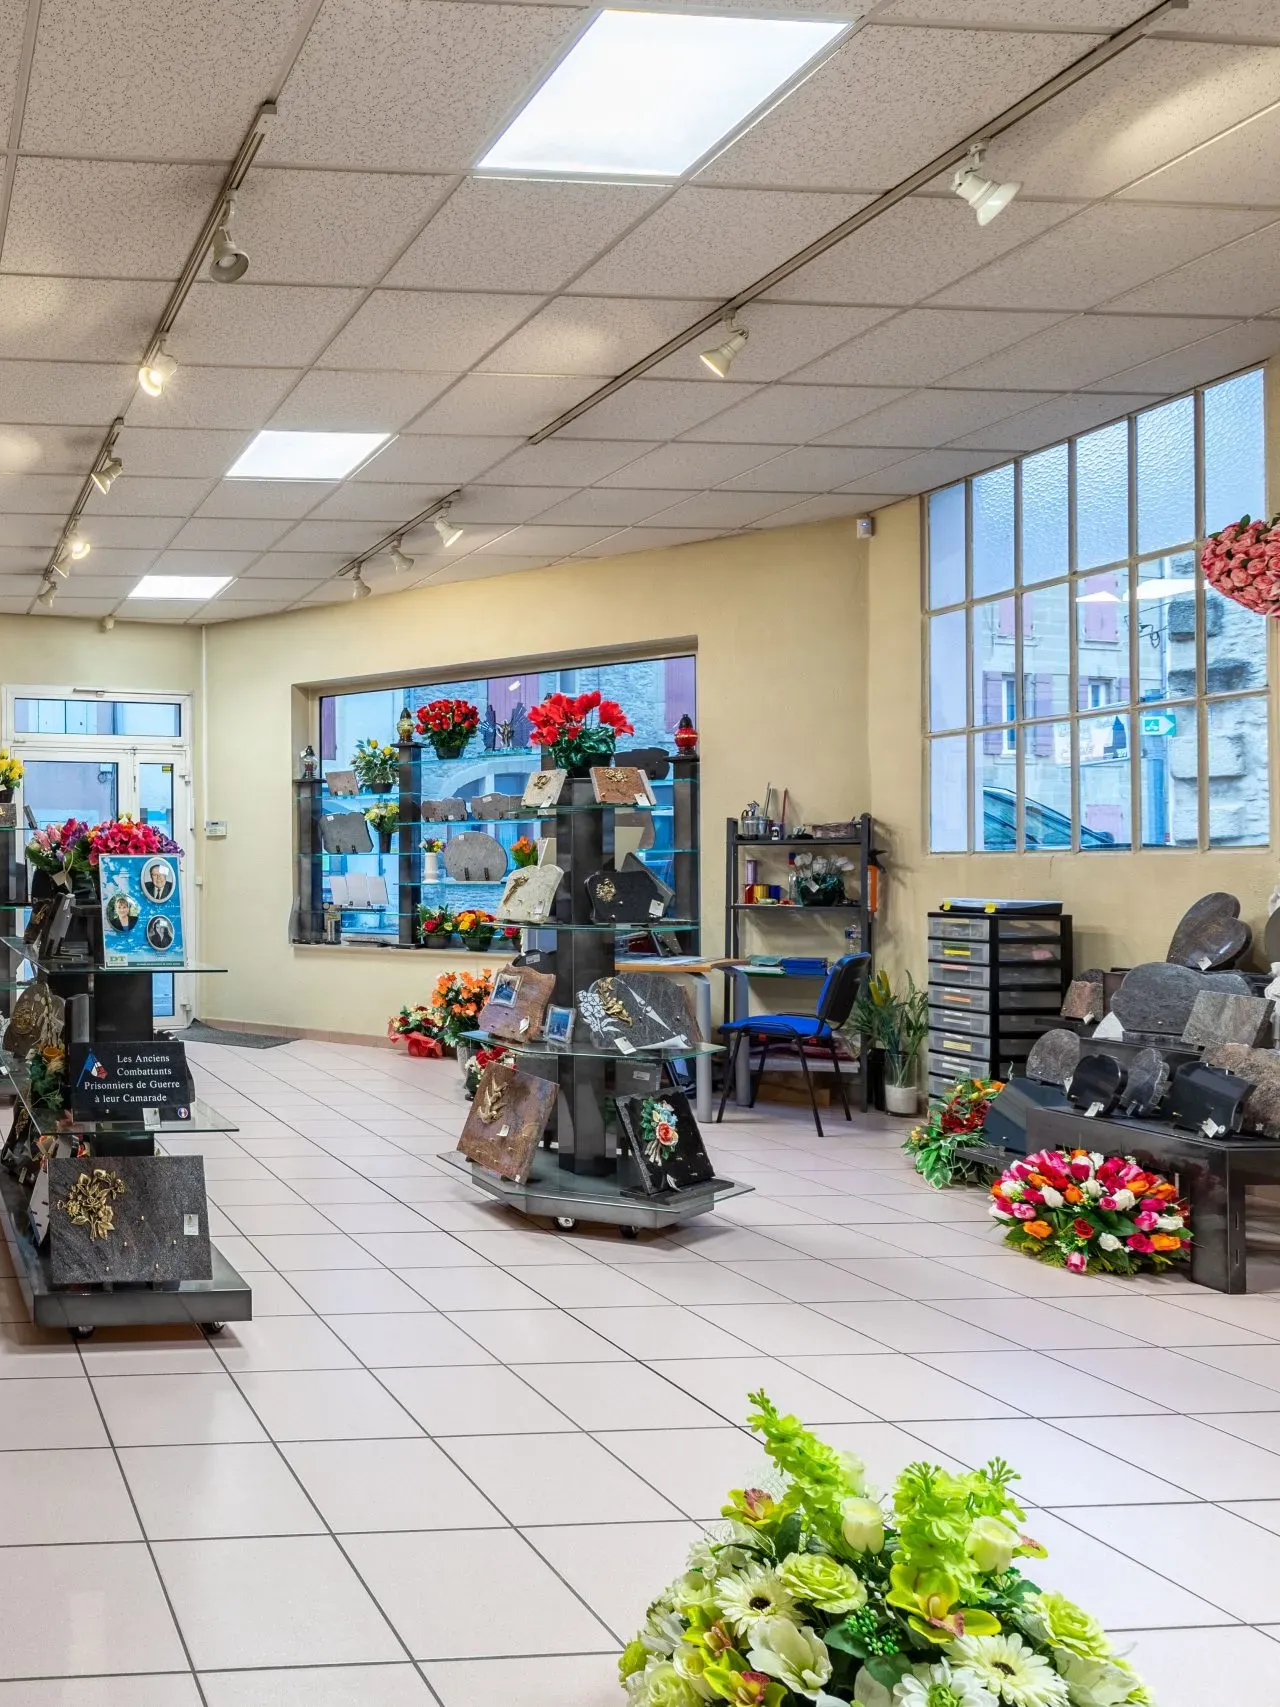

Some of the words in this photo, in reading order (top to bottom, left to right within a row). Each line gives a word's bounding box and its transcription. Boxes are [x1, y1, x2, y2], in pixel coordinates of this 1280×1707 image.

[116, 1055, 132, 1063] Les
[135, 1054, 170, 1063] Anciens
[116, 1067, 172, 1076] Combattants
[84, 1081, 134, 1090] Prisonniers
[136, 1080, 147, 1089] de
[149, 1080, 180, 1089] Guerre
[94, 1095, 100, 1103] à
[103, 1095, 120, 1103] leur
[122, 1093, 167, 1102] Camarade
